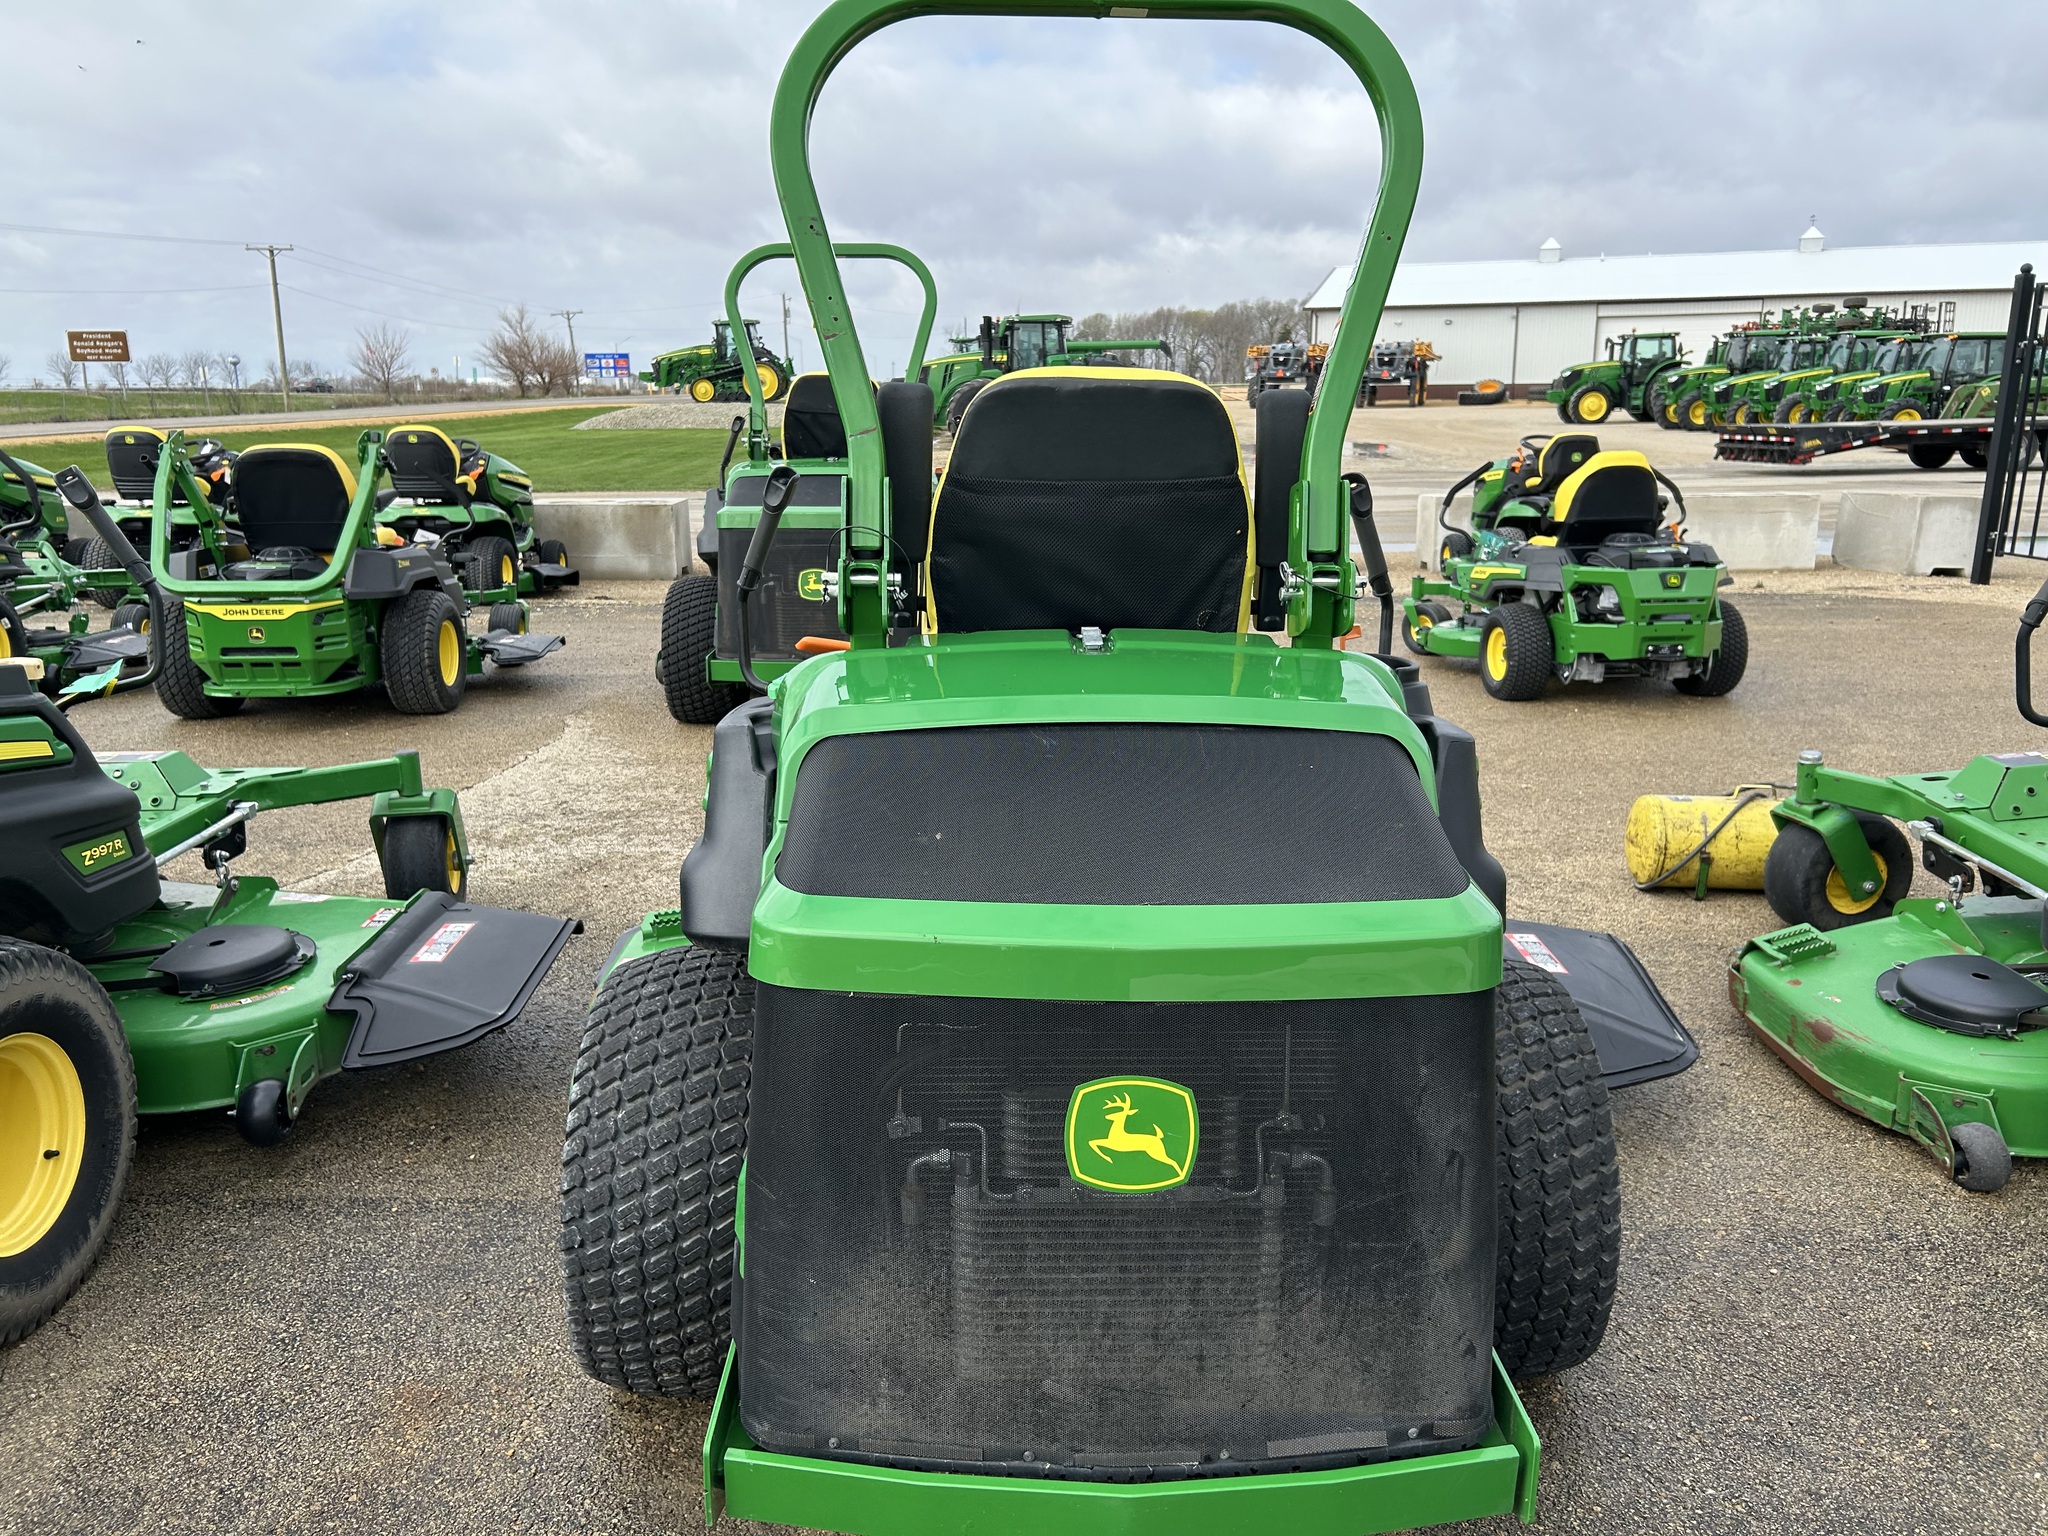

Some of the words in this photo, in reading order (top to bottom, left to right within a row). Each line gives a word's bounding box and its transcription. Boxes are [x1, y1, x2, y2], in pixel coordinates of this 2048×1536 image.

[223, 608, 249, 616] JOHN
[251, 608, 285, 616] DEERE
[82, 839, 123, 866] Z997R
